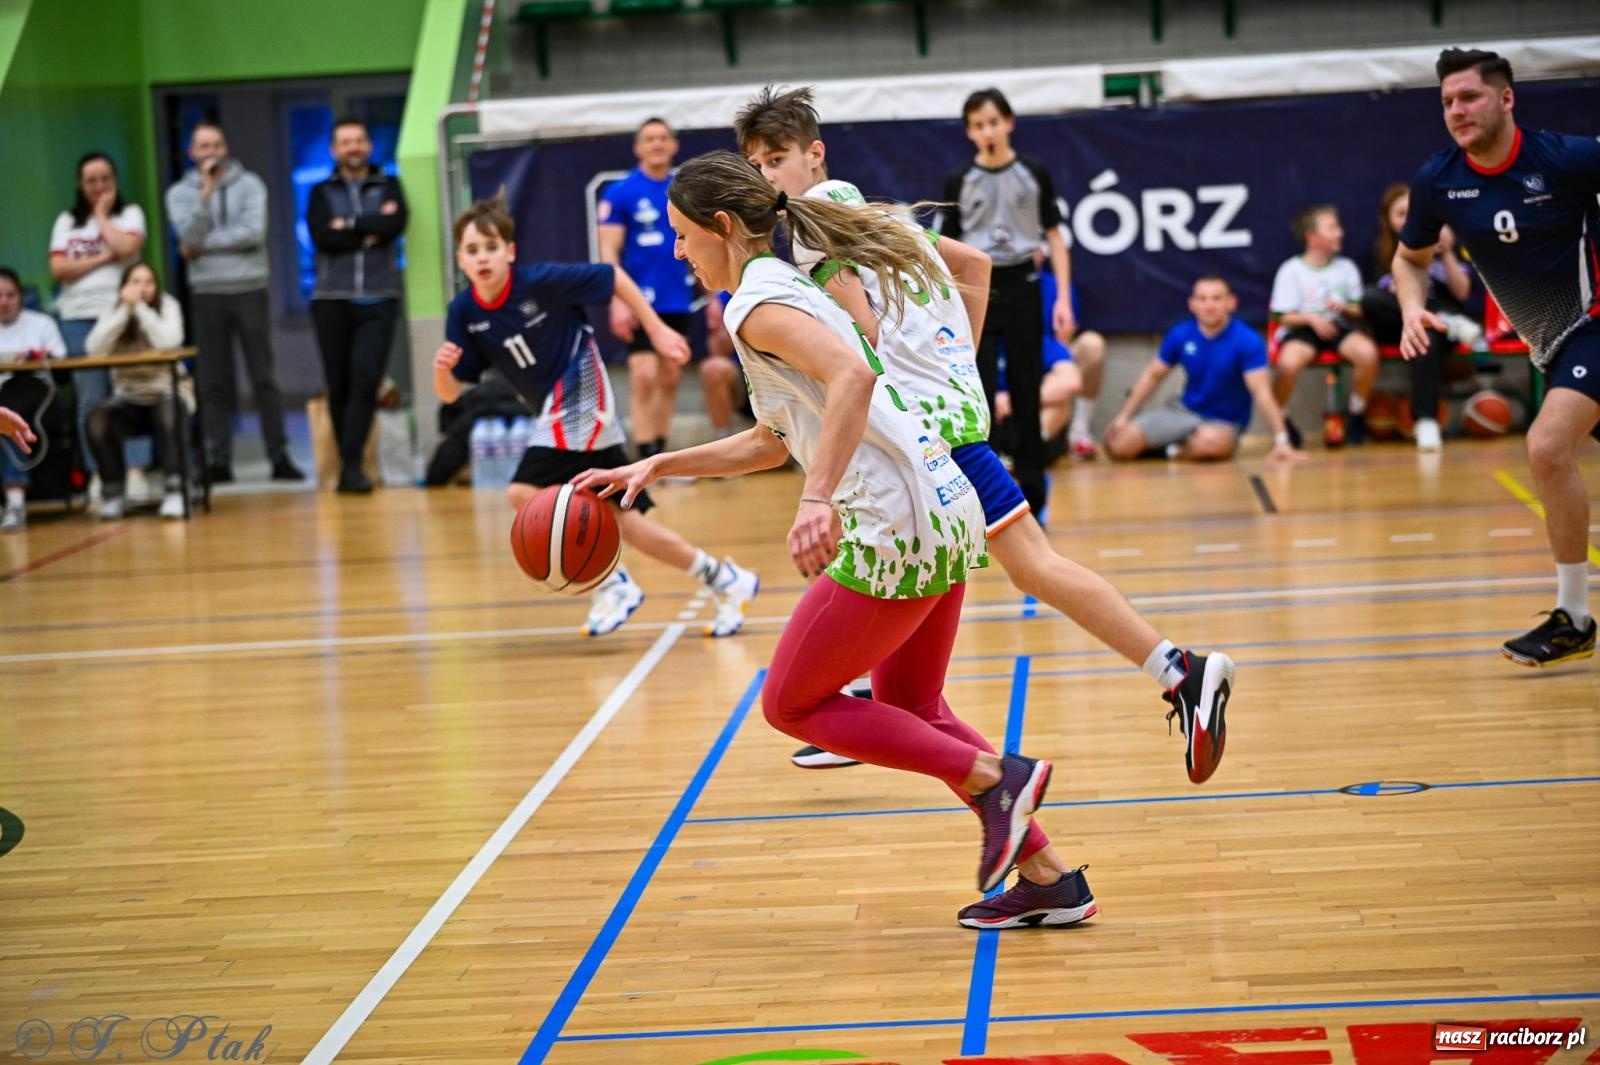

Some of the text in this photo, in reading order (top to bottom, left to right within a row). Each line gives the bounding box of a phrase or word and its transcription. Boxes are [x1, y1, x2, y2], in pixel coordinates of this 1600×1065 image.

[1056, 168, 1252, 256] ÓRZ
[1493, 210, 1519, 243] 9
[503, 333, 536, 369] 11
